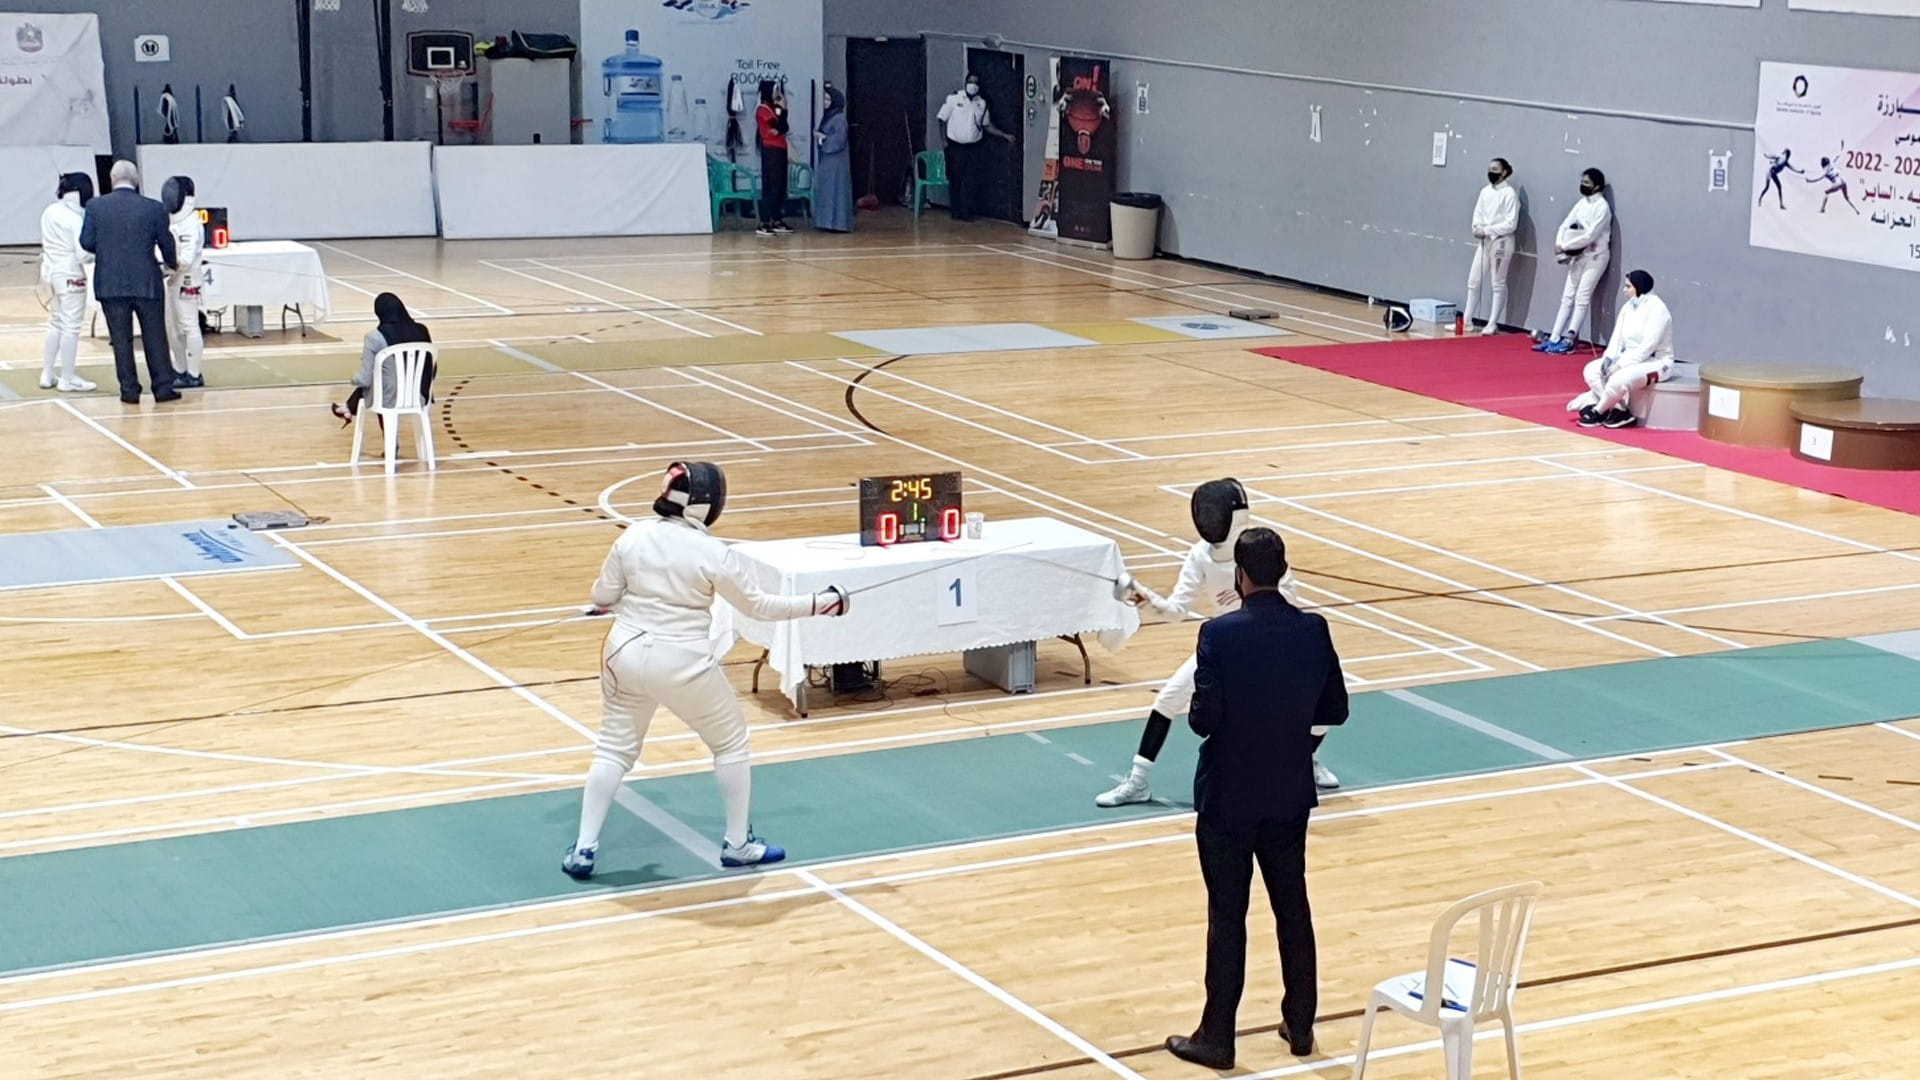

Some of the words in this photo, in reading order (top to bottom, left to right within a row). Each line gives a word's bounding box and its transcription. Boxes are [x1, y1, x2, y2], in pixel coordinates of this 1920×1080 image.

[757, 59, 781, 69] Free
[0, 75, 32, 86] بطول
[1894, 155, 1920, 176] 202
[213, 228, 228, 248] 0
[203, 268, 214, 286] 4
[891, 478, 933, 502] 2:45
[880, 513, 897, 543] 0
[943, 509, 960, 538] 0
[949, 578, 961, 607] 1
